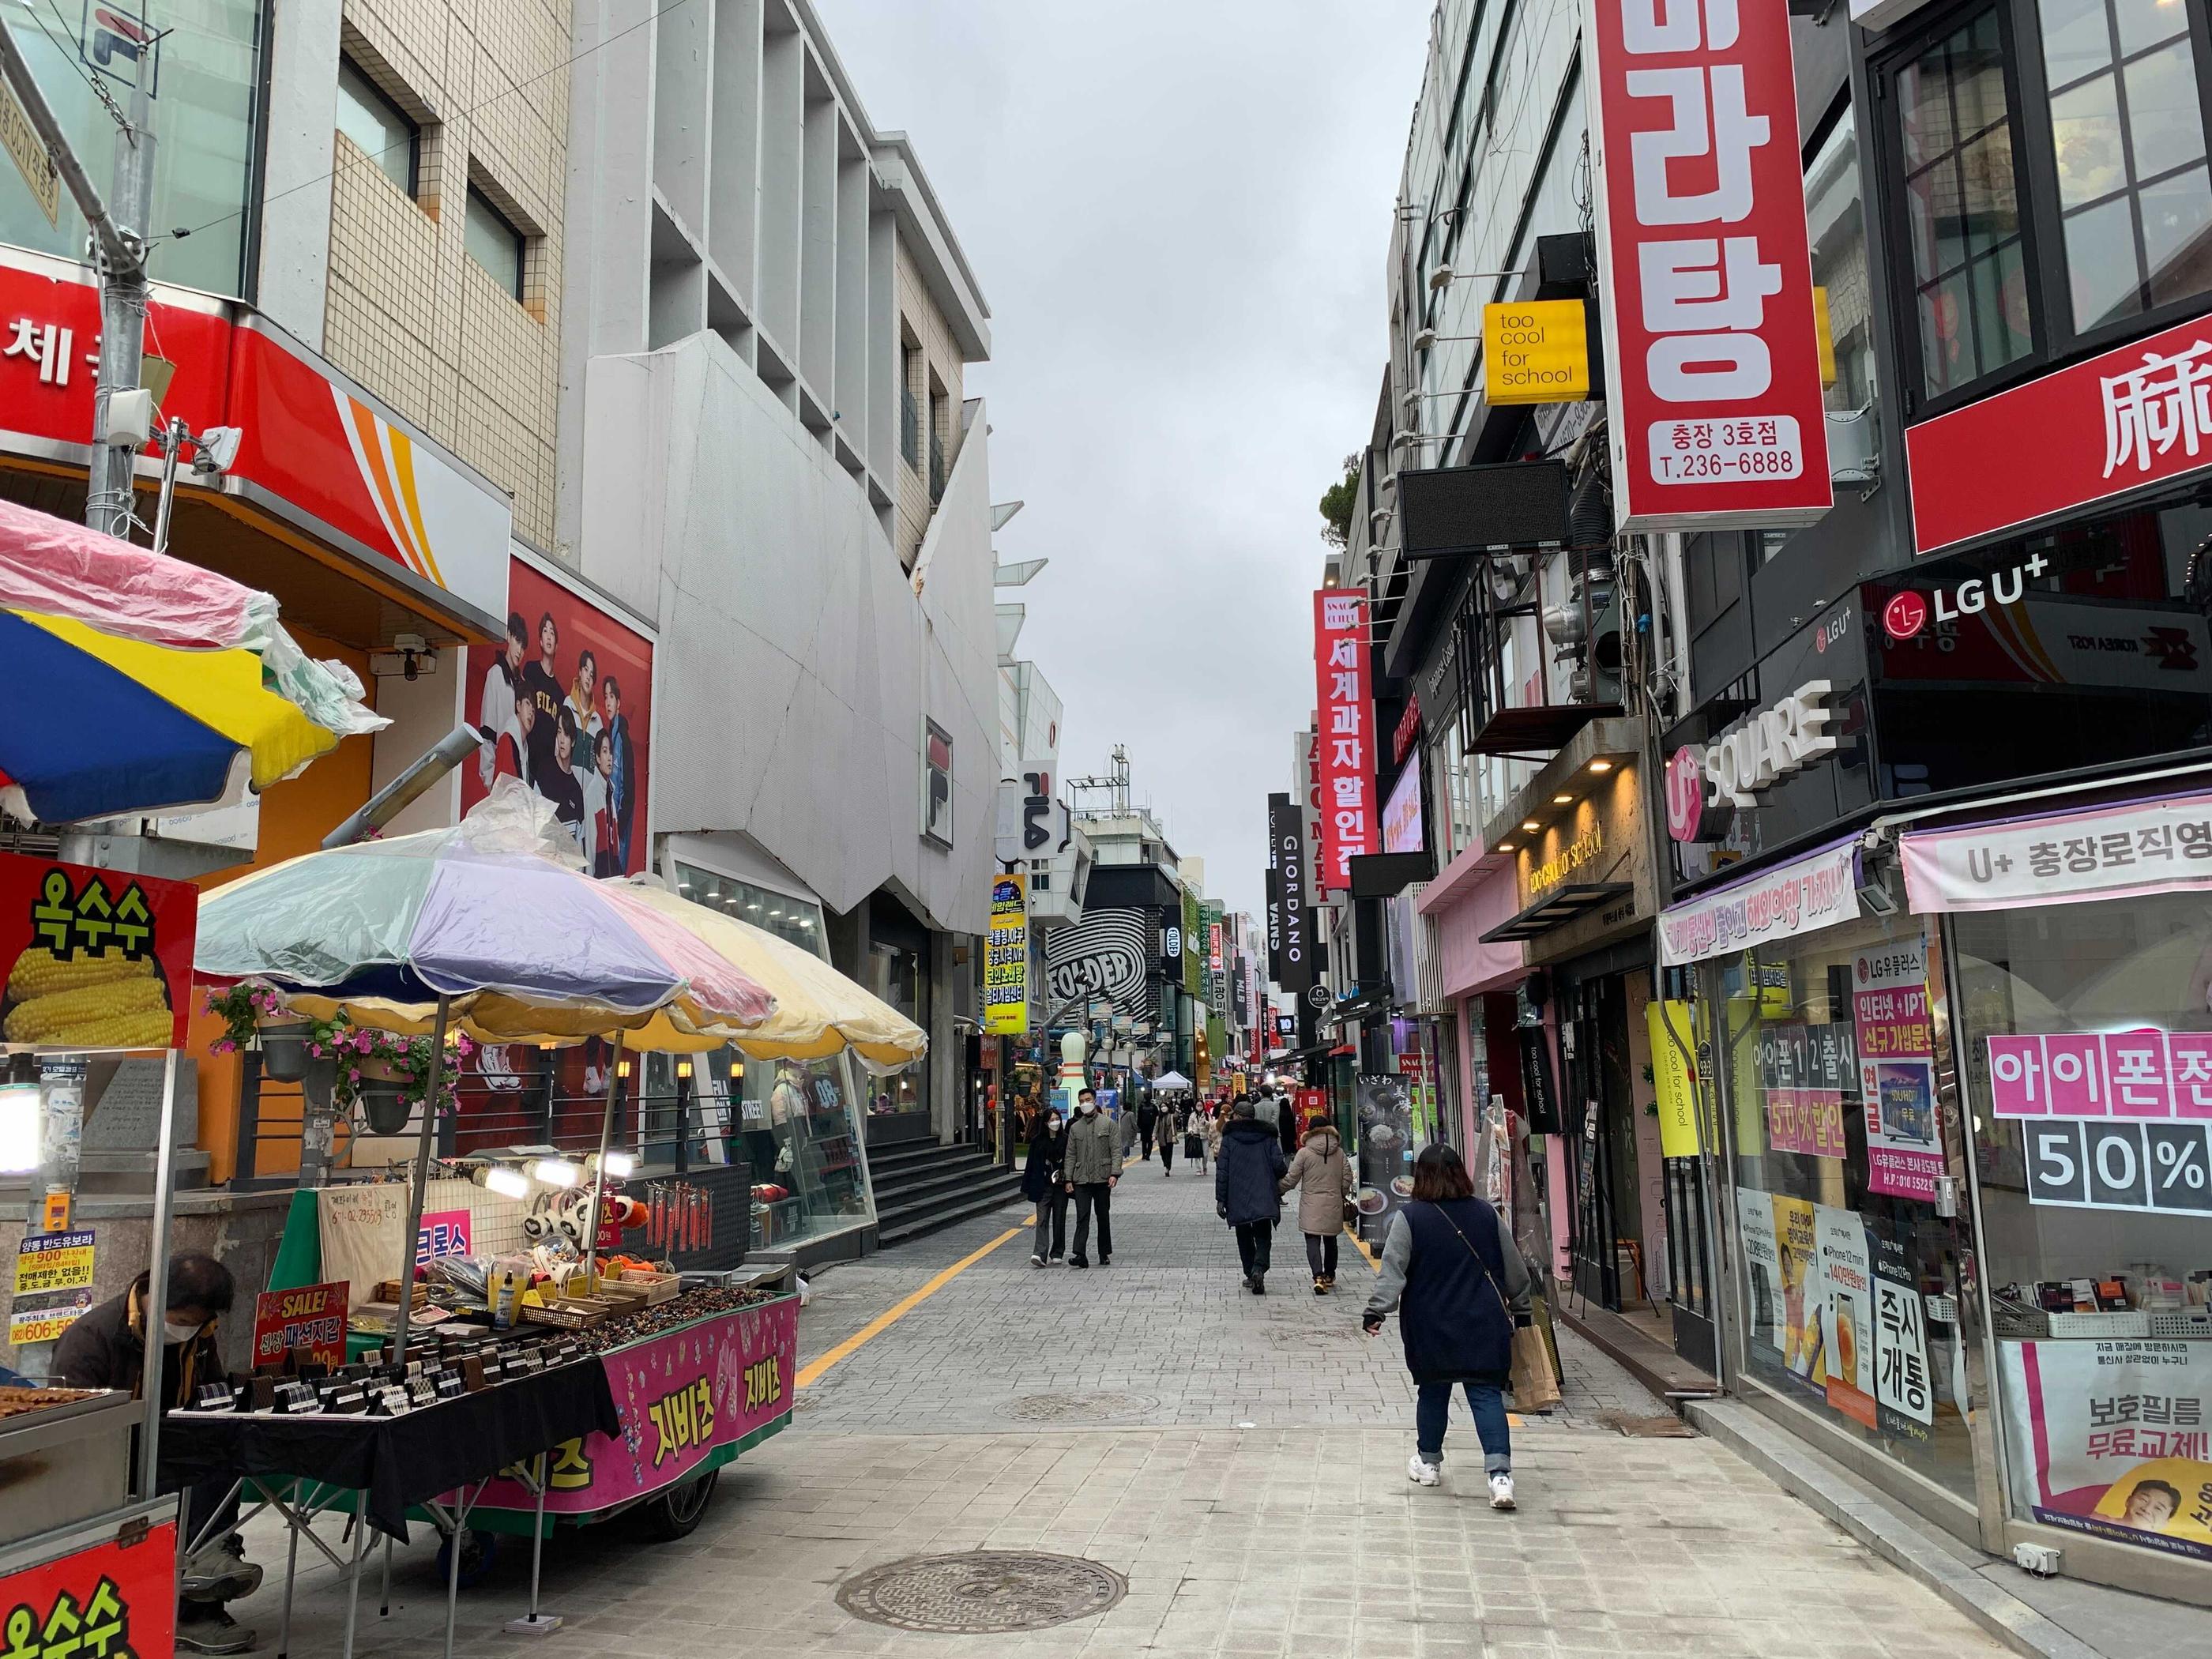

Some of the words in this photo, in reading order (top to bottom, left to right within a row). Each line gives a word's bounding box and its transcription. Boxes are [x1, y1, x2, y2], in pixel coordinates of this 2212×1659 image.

[11, 112, 33, 169] CCTV
[1500, 314, 1534, 329] too
[1500, 327, 1545, 345] cool
[1500, 350, 1530, 366] for
[1502, 367, 1573, 385] school
[1672, 423, 1713, 451] 충장
[1722, 420, 1778, 448] 3호점
[1659, 450, 1793, 480] T.236-6888
[1933, 552, 2048, 623] LGU+
[1826, 607, 1851, 645] LGU+
[1328, 638, 1362, 769] 세계과자
[1705, 679, 1837, 808] SQUARE
[1023, 772, 1050, 850] FILA
[1571, 820, 1602, 867] school
[1967, 848, 2013, 883] U+
[35, 871, 150, 951] 옥수수
[1283, 834, 1301, 963] GIORDANO
[1747, 878, 1802, 931] 해외여행
[1269, 901, 1280, 951] VANS
[1168, 929, 1179, 956] FOLDER
[986, 965, 1025, 984] 코인노래방
[1048, 952, 1129, 999] FOLDER
[1870, 956, 1920, 979] LG유플러스
[1236, 979, 1245, 1003] MLB
[1860, 995, 1894, 1023] 인터넷
[1864, 1030, 1888, 1055] 신규
[1232, 1063, 1245, 1073] kt
[1669, 1049, 1681, 1072] cool
[1699, 1060, 1711, 1075] 93-3
[1673, 1075, 1682, 1089] for
[741, 1099, 764, 1120] STREET
[1537, 1089, 1547, 1114] school
[1675, 1092, 1688, 1127] school
[2038, 1134, 2205, 1190] 50%
[22, 1240, 41, 1253] 양동
[43, 1234, 93, 1250] 반도유보라
[1827, 1246, 1846, 1262] iPhone
[19, 1270, 58, 1283] 전매제한
[61, 1266, 89, 1277] 없음!!
[1882, 1259, 1898, 1277] iPhone
[1903, 1269, 1912, 1282] Pro
[281, 1291, 329, 1319] SALE!
[1881, 1288, 1920, 1352] 즉시
[259, 1330, 284, 1356] 신상
[284, 1316, 341, 1349] 패션지갑
[2096, 1343, 2114, 1352] 지금
[2116, 1342, 2142, 1352] 매장에
[2144, 1342, 2188, 1352] 방문하시면
[2097, 1355, 2124, 1365] 통신사
[2125, 1355, 2160, 1365] 상관없이
[2162, 1355, 2188, 1365] 누구나
[743, 1353, 782, 1416] 지비츠
[1883, 1347, 1927, 1412] 개통
[647, 1373, 715, 1469] 지비츠
[2090, 1394, 2203, 1428] 보호필름
[2086, 1428, 2210, 1462] 무료교체!
